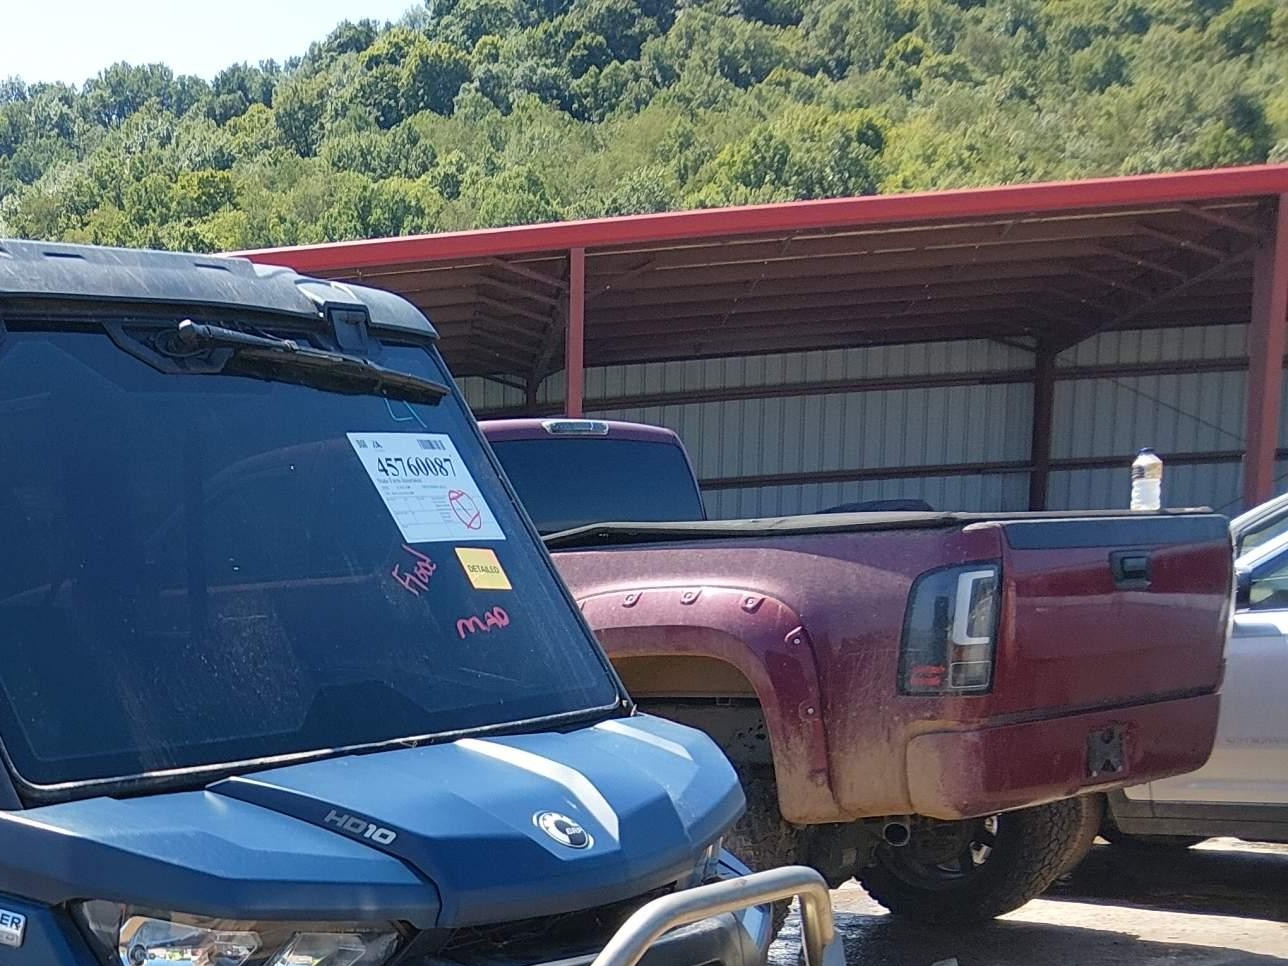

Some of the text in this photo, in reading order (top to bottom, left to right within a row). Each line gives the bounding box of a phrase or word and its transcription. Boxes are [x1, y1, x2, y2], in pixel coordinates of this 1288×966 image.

[377, 457, 456, 477] 45760087
[467, 564, 500, 574] DETAILED
[324, 809, 397, 845] HD10
